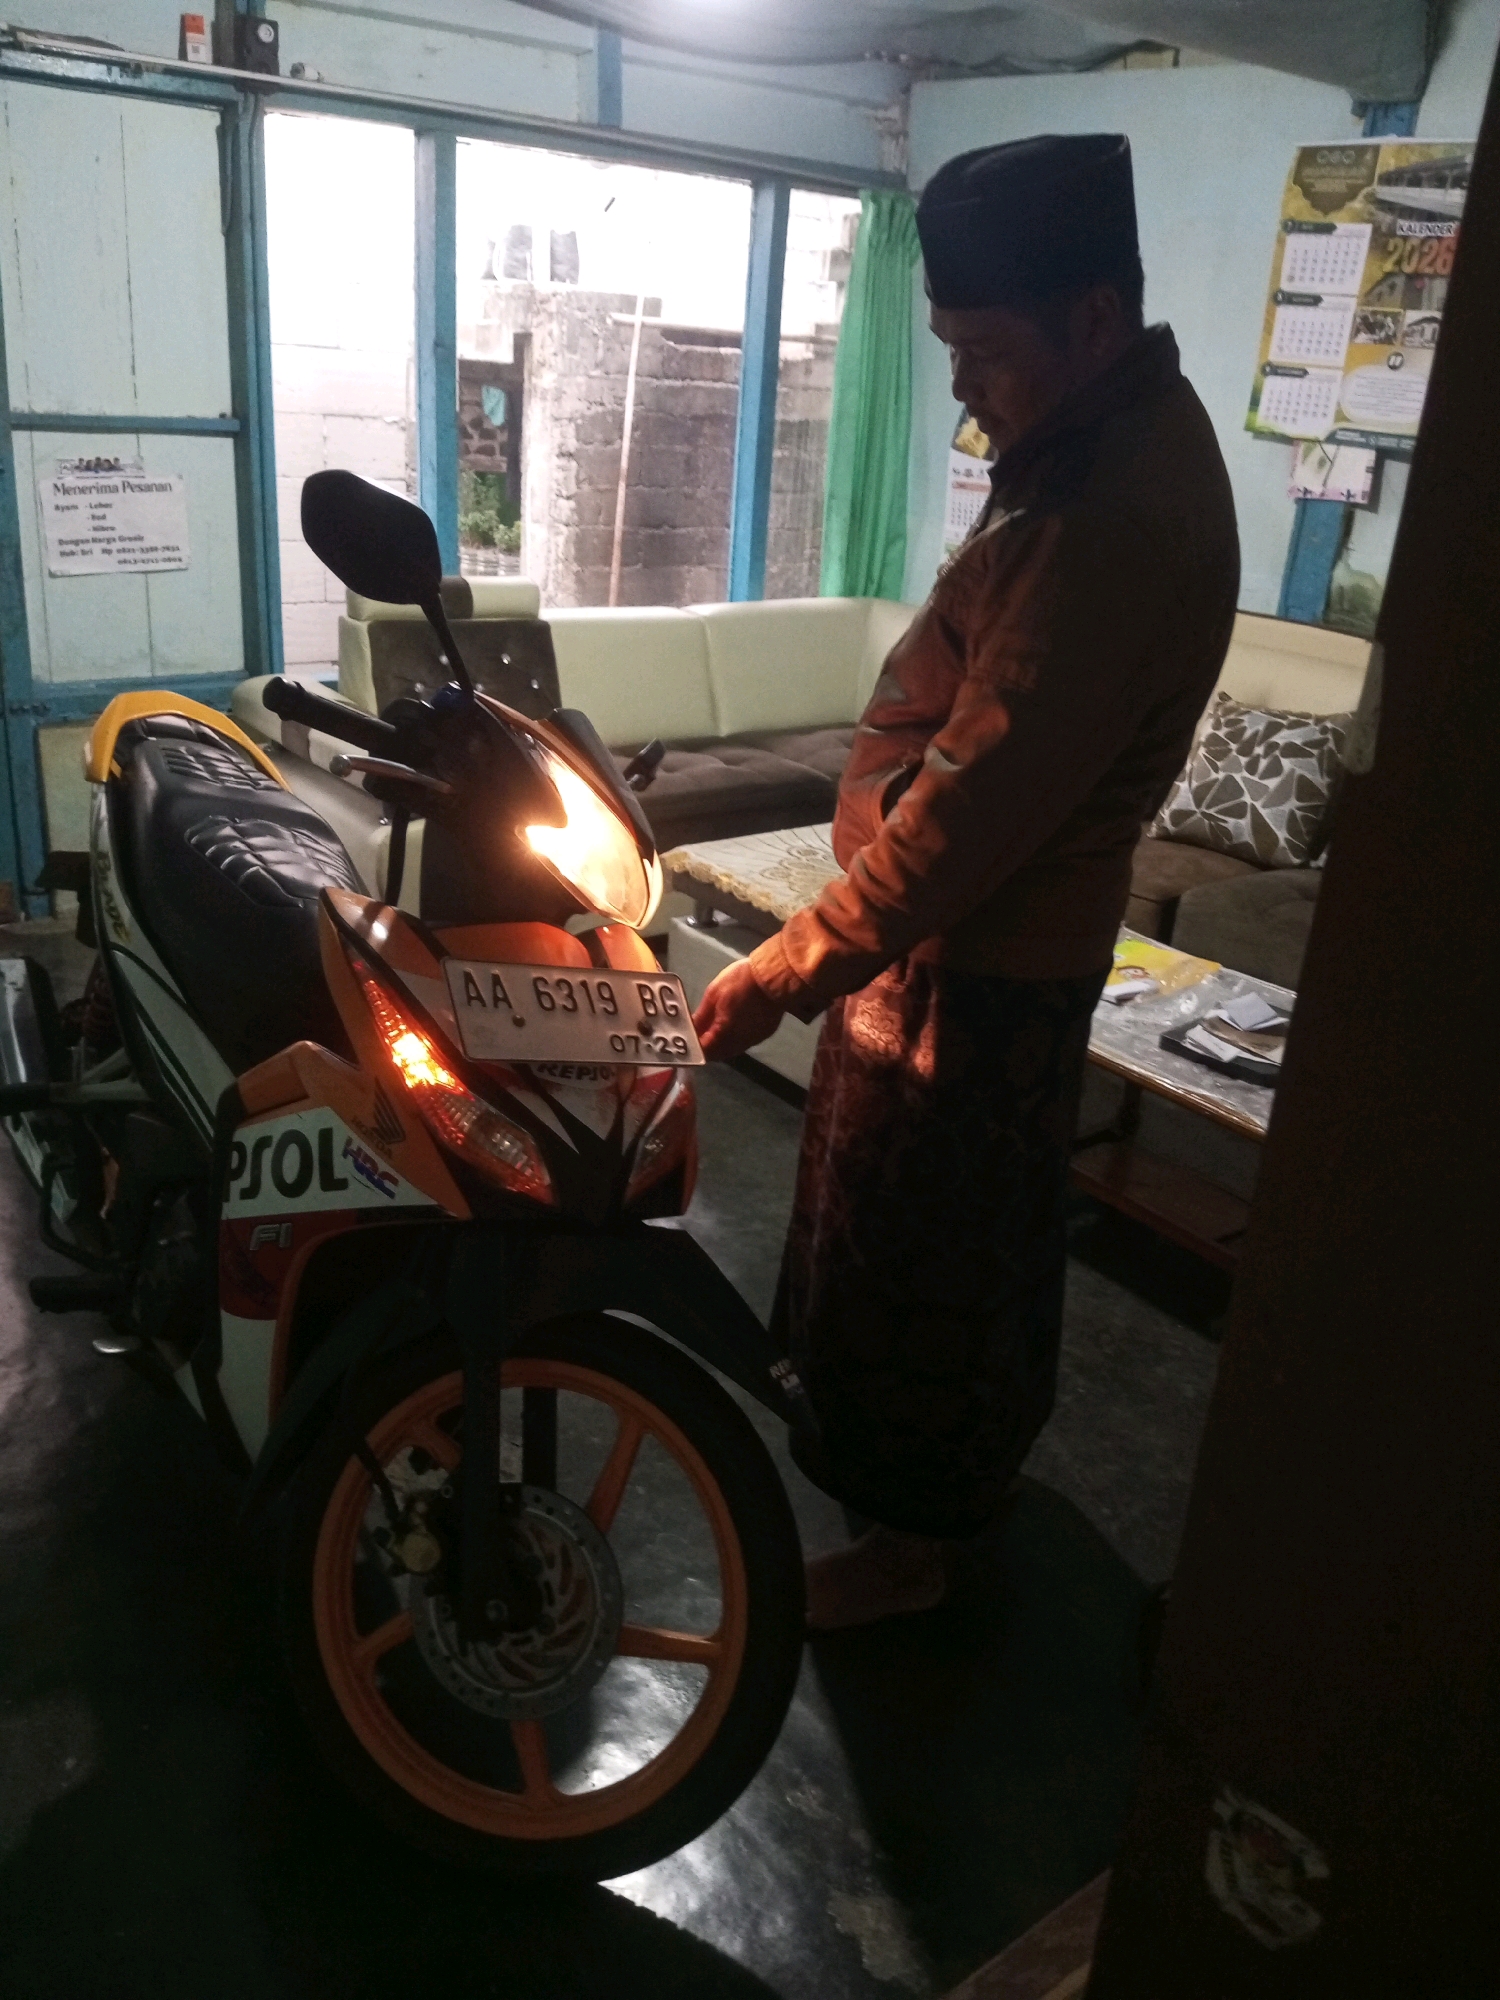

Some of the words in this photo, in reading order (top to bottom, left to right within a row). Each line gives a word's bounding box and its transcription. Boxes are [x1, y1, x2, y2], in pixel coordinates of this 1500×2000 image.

[1398, 221, 1456, 236] KALENDER
[1382, 237, 1457, 274] 2026
[53, 482, 119, 496] Menerima
[122, 480, 172, 494] Pesanan
[463, 970, 513, 1009] AA
[532, 976, 619, 1016] 6319
[636, 982, 680, 1018] BG
[536, 1062, 615, 1081] REPSO
[343, 1136, 399, 1200] HRC
[249, 1222, 294, 1251] FI
